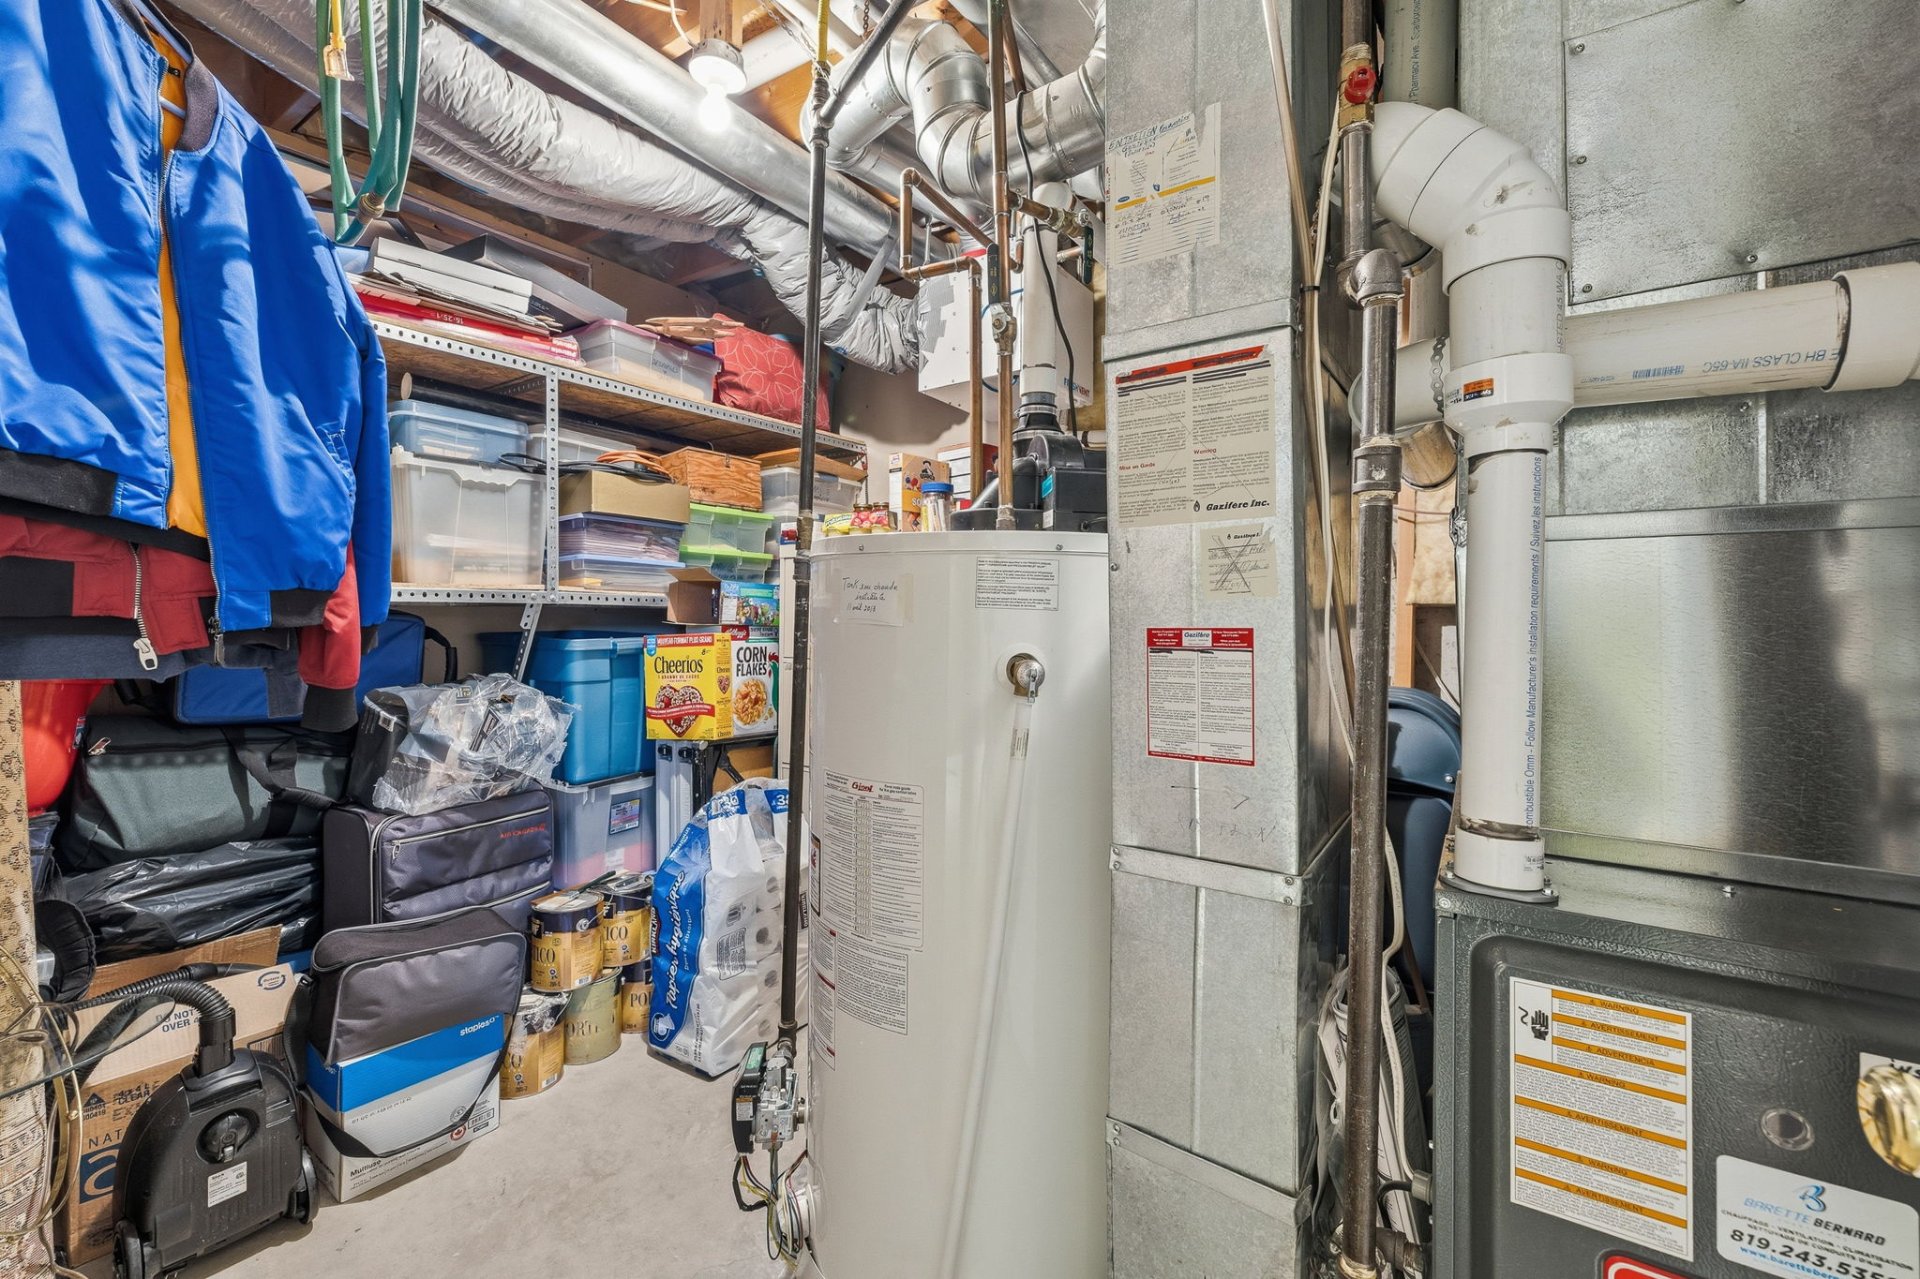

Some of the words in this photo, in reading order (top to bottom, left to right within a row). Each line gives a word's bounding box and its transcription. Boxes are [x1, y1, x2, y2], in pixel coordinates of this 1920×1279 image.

[1752, 351, 1801, 369] CLASS
[1531, 456, 1542, 500] instructions
[1250, 499, 1270, 508] Inc.
[1531, 505, 1542, 520] les
[1530, 520, 1541, 547] Suivez
[1530, 554, 1540, 609] requirements
[1528, 609, 1539, 655] installation
[736, 646, 768, 662] CORN
[654, 655, 703, 675] Cheerios
[736, 662, 767, 677] FLAKES
[1526, 656, 1537, 718] Manufacturer's
[1525, 719, 1536, 748] Follow
[666, 871, 685, 955] hygiénique
[666, 955, 679, 1009] Papier
[174, 1009, 194, 1020] NOT
[1600, 1001, 1639, 1014] WARNING
[162, 1020, 191, 1033] OVER
[460, 1019, 490, 1037] staples
[1591, 1022, 1659, 1042] AVERTISSEMENT
[1597, 1047, 1655, 1066] ADVERTENCIA
[1587, 1073, 1626, 1088] WARNING
[1575, 1114, 1643, 1137] AVERTISSEMENT
[1588, 1159, 1628, 1176] WARNING
[1576, 1188, 1643, 1214] AVERTISSEMENT
[1744, 1198, 1810, 1223] BARETTE
[1814, 1218, 1886, 1246] BERNARD
[1730, 1229, 1897, 1279] 819.243.535
[1778, 1226, 1834, 1247] VENTILATION
[1843, 1245, 1914, 1271] CLIMATISATION
